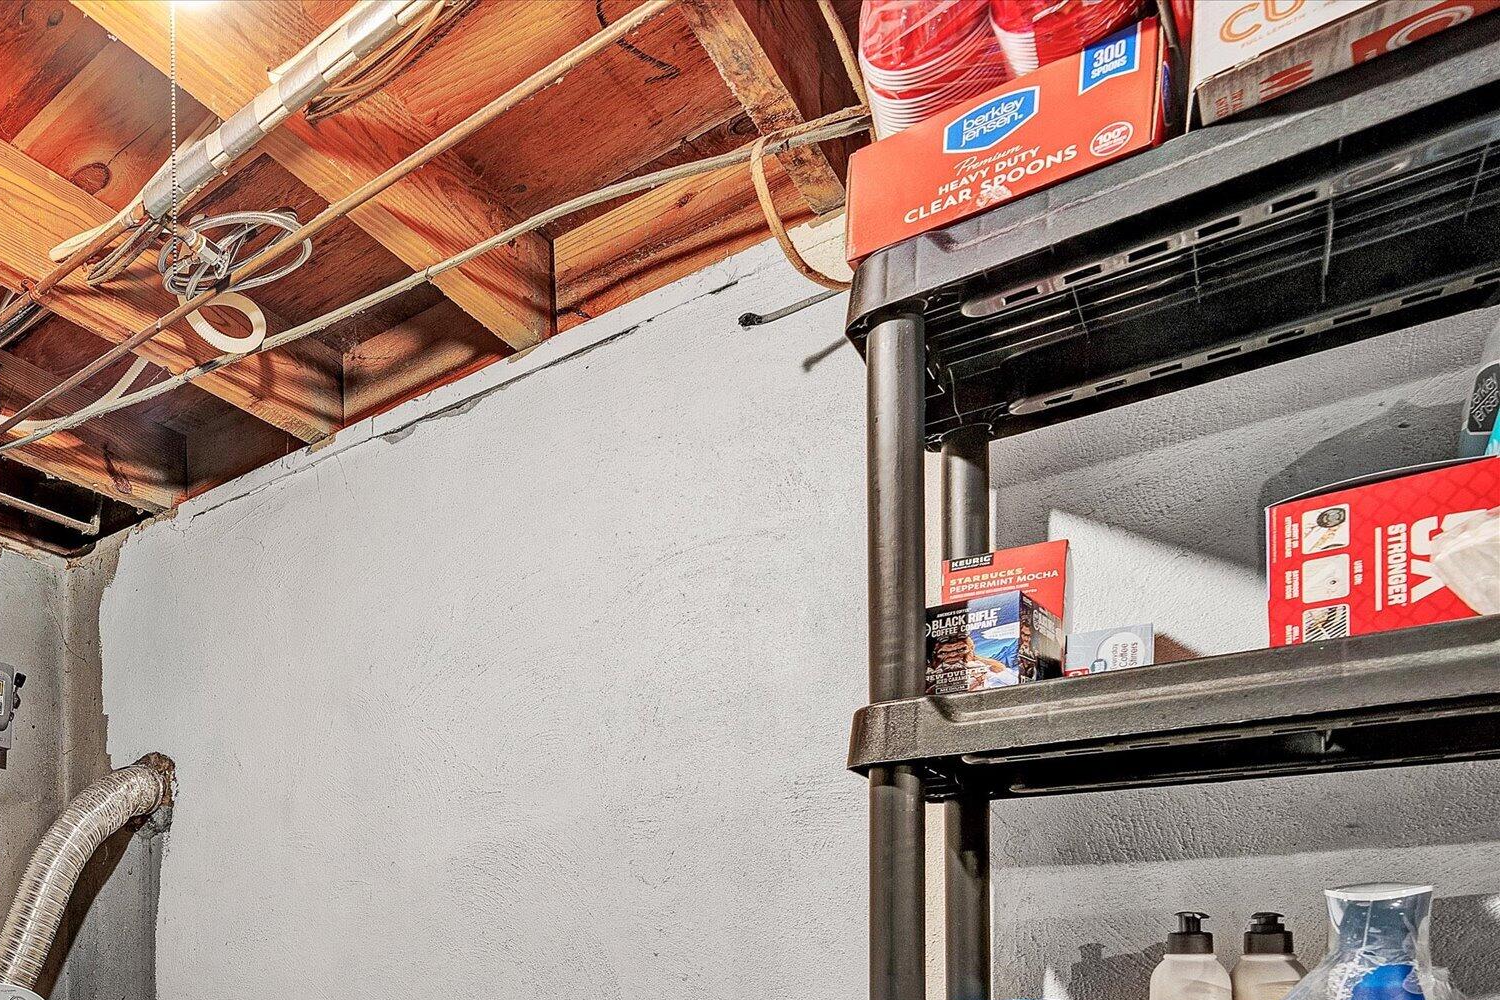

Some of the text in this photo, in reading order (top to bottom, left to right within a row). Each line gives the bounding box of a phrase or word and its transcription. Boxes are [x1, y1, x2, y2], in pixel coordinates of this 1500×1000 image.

[1093, 40, 1127, 67] 300
[1091, 56, 1128, 78] SPOONS
[963, 97, 1024, 131] berkley
[938, 146, 1041, 195] HEAVY DUTY
[954, 144, 1023, 175] Premium
[903, 145, 1078, 224] CLEAR SPOONS
[951, 555, 993, 569] KEURIG
[1387, 523, 1407, 606] STRONGER
[949, 578, 1015, 594] PEPPERMINT
[1016, 569, 1059, 582] MOCHA
[950, 567, 1024, 586] STARBUCKS
[931, 607, 1000, 630] BLACK RIFLE
[931, 619, 998, 638] COFFEE COMPANY
[1119, 643, 1129, 667] Coffee
